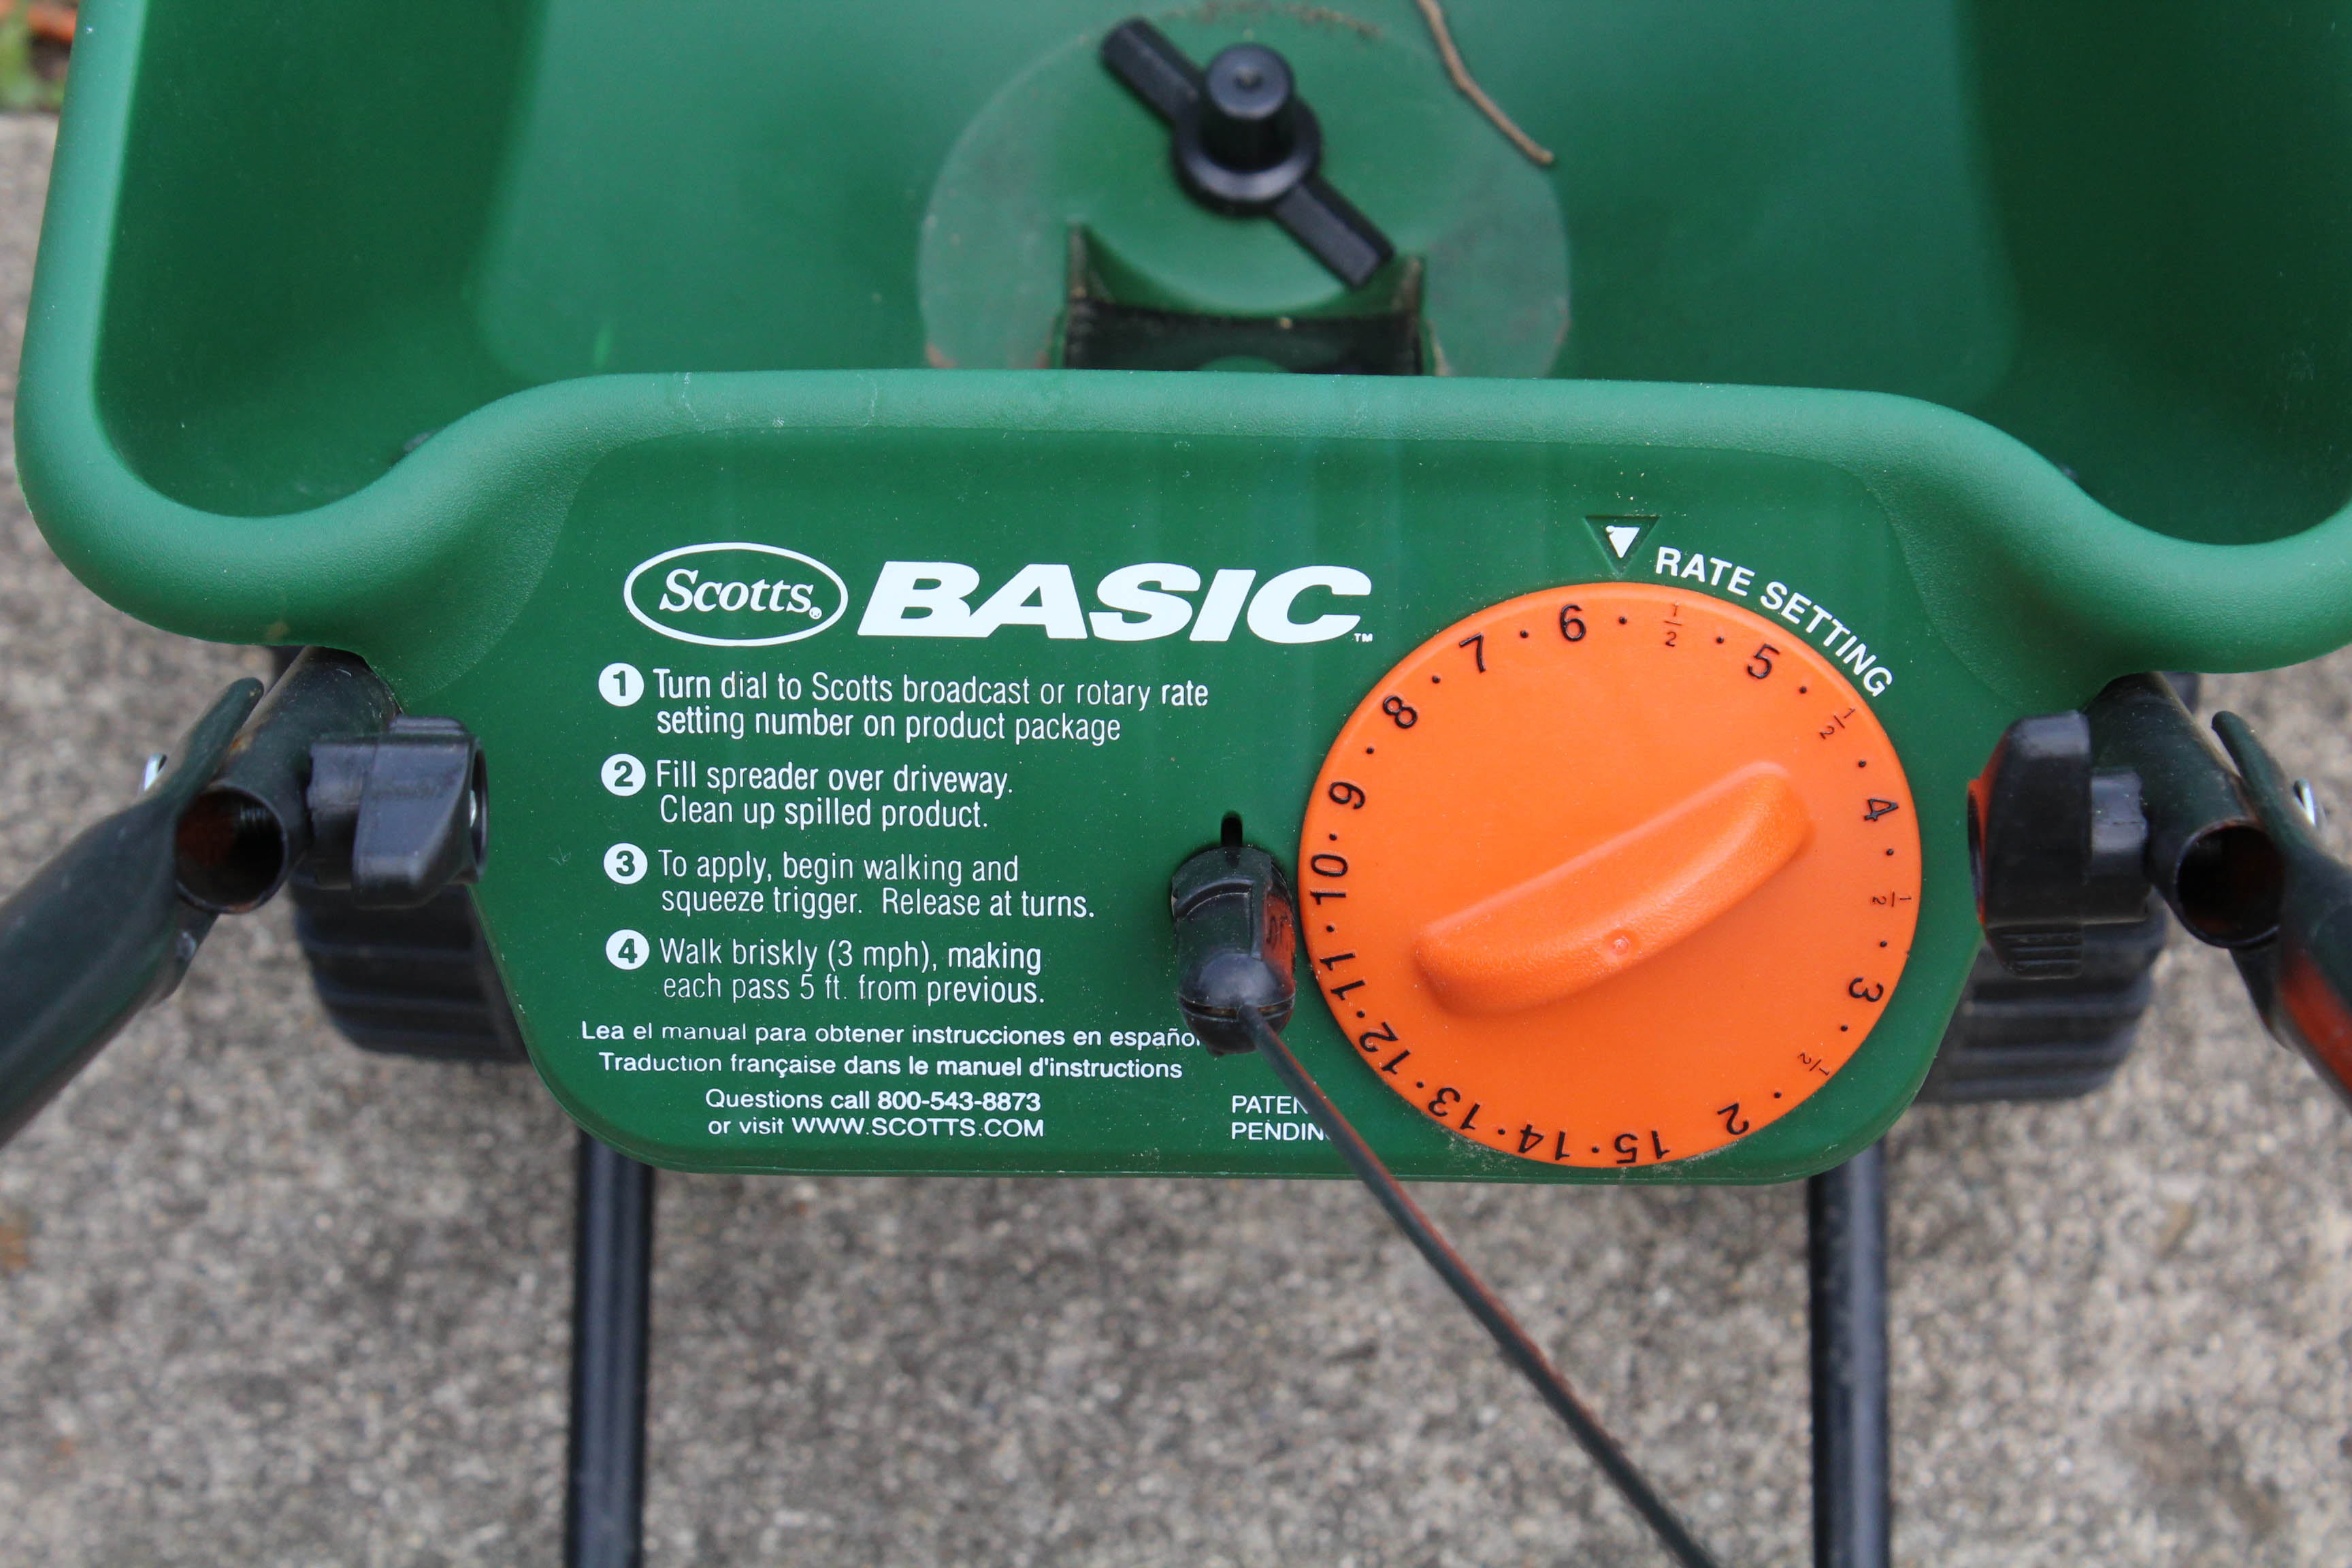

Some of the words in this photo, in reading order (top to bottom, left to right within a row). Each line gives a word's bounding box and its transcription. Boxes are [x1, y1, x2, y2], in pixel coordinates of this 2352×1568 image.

[659, 568, 815, 612] Scotts
[857, 561, 1372, 644] BASIC
[1559, 604, 1587, 642] 6
[1655, 546, 1756, 597] RATE
[1760, 581, 1893, 698] SETTING
[1458, 633, 1486, 674] 7
[1746, 643, 1780, 680] 5
[652, 668, 710, 699] Turn
[721, 670, 767, 699] dial
[777, 672, 802, 700] to
[812, 671, 893, 702] Scotts
[903, 674, 1030, 705] broadcast
[1040, 683, 1065, 705] or
[1077, 680, 1151, 712] rotary
[1161, 680, 1209, 706] rate
[657, 705, 745, 740] setting
[755, 707, 854, 736] number
[864, 715, 895, 737] on
[906, 710, 1005, 744] product
[1015, 712, 1121, 747] package
[1382, 695, 1418, 730] 8
[657, 760, 696, 788] Fill
[706, 761, 819, 795] spreader
[828, 768, 884, 791] over
[893, 764, 1013, 800] driveway.
[1328, 781, 1366, 810] 9
[660, 794, 733, 823] Clean
[744, 802, 775, 830] up
[784, 796, 871, 831] spilled
[881, 799, 988, 832] product.
[1863, 798, 1899, 822] 4
[657, 849, 687, 877] To
[697, 850, 772, 885] apply,
[783, 851, 853, 885] begin
[863, 853, 962, 887] walking
[972, 855, 1018, 883] and
[1309, 853, 1349, 906] 10
[662, 890, 764, 917] squeeze
[772, 886, 862, 919] trigger.
[883, 887, 980, 916] Release
[990, 890, 1012, 917] at
[1021, 890, 1094, 918] turns.
[659, 937, 722, 964] Walk
[732, 938, 818, 973] briskly
[828, 939, 853, 973] (3
[864, 940, 936, 973] mph),
[948, 941, 1041, 976] making
[664, 972, 721, 998] each
[732, 978, 790, 1004] pass
[800, 973, 815, 1000] 5
[825, 973, 847, 1000] ft.
[858, 974, 916, 1001] from
[927, 975, 1045, 1007] previous.
[1319, 951, 1366, 1002] 11
[1848, 977, 1884, 1002] 3
[582, 1020, 625, 1040] Lea
[633, 1022, 653, 1040] el
[662, 1023, 747, 1041] manual
[755, 1026, 807, 1045] para
[815, 1024, 904, 1043] obtener
[912, 1025, 1065, 1046] instrucciones
[1073, 1029, 1102, 1046] en
[1358, 1020, 1411, 1075] 12
[598, 1051, 722, 1072] Traduction
[730, 1054, 836, 1079] française
[844, 1055, 901, 1075] dans
[909, 1056, 929, 1075] le
[936, 1056, 1022, 1077] manuel
[1029, 1056, 1183, 1079] d'instructions
[705, 1088, 823, 1109] Questions
[830, 1088, 870, 1109] call
[877, 1090, 1041, 1112] 800-543-8873
[1427, 1087, 1480, 1132] 13
[1716, 1102, 1750, 1136] 2
[708, 1117, 731, 1137] or
[738, 1117, 785, 1137] visit
[791, 1117, 1044, 1137] WWW.SCOTTS.COM
[1231, 1122, 1330, 1141] PENDIN
[1517, 1124, 1571, 1162] 14
[1614, 1129, 1671, 1164] 15
